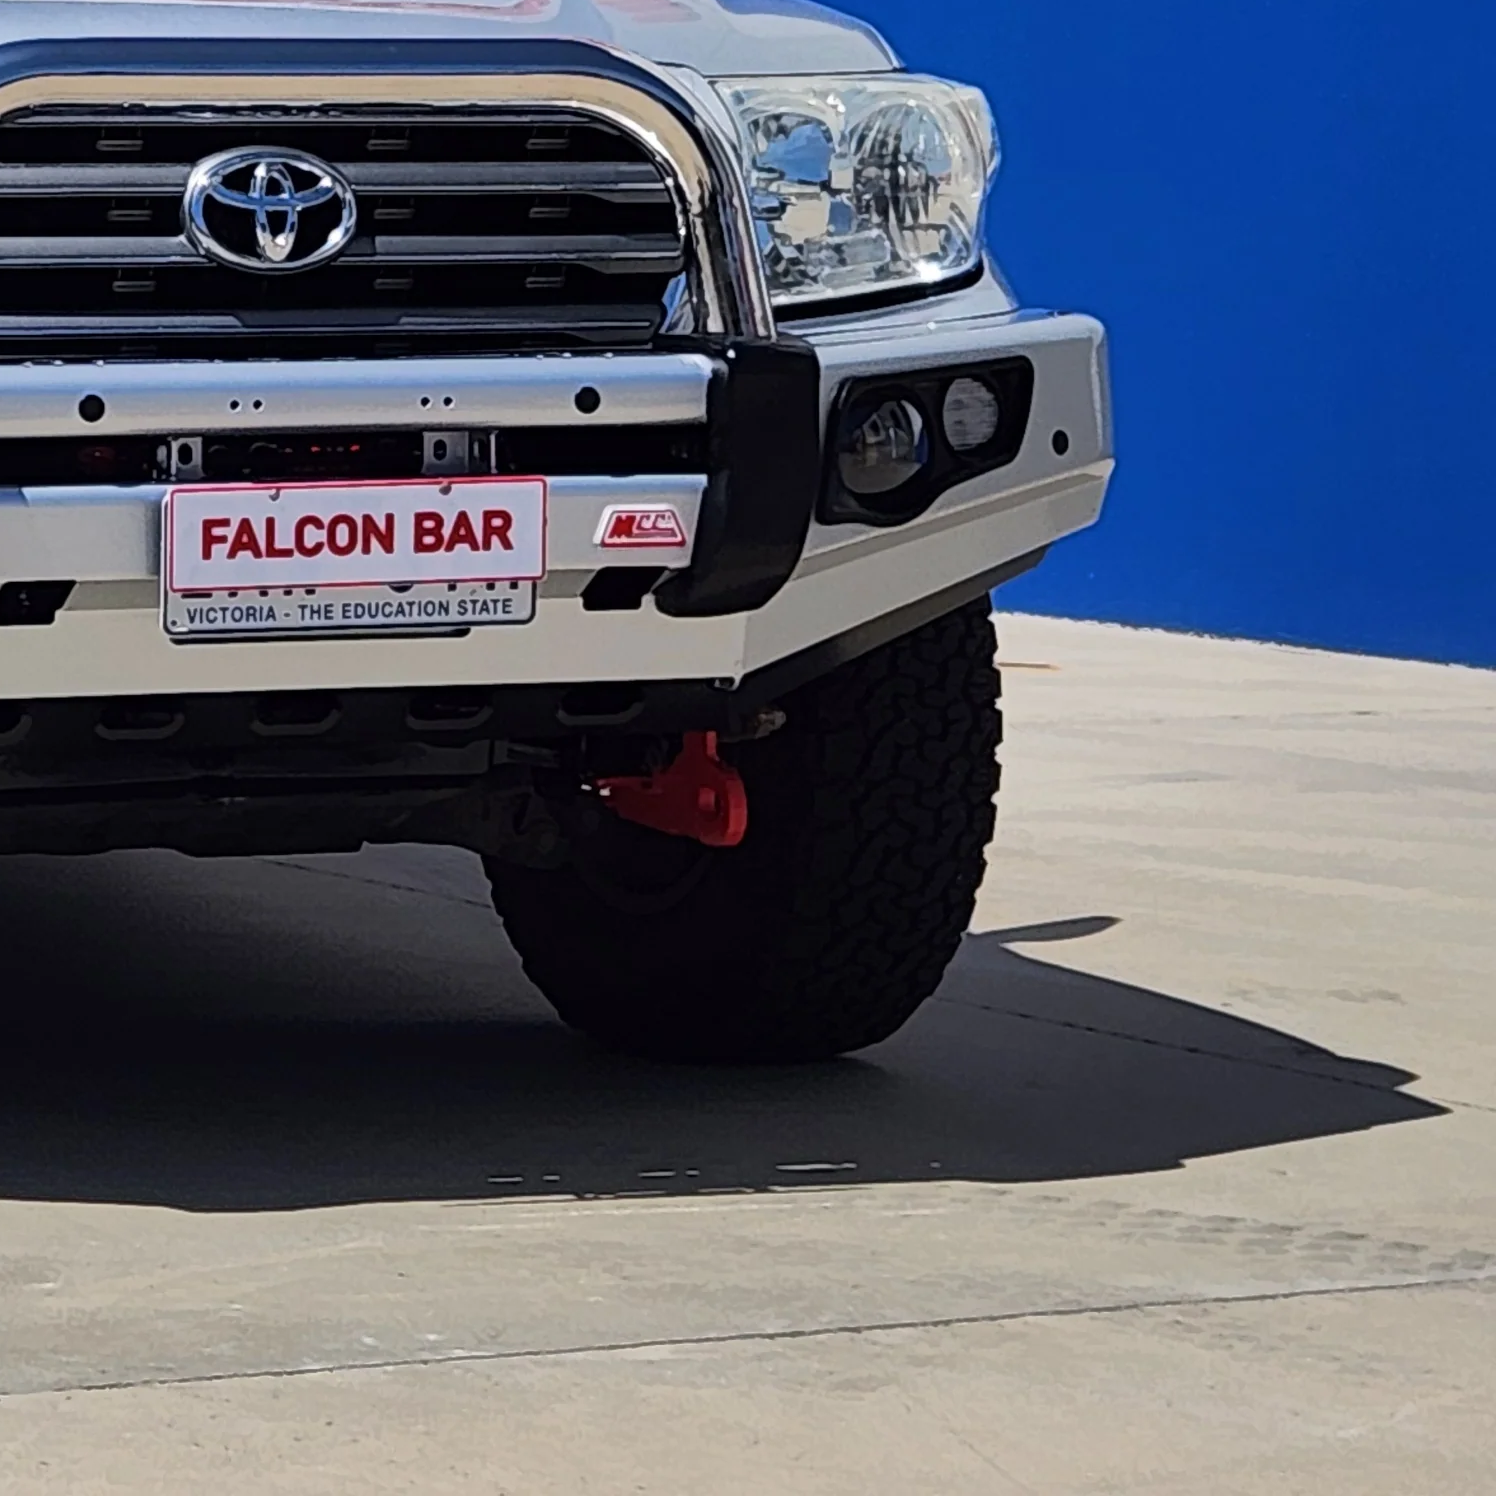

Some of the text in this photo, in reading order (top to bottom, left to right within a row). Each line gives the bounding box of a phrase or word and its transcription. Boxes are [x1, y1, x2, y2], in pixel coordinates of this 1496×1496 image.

[201, 509, 515, 561] FALCON BAR
[186, 605, 277, 625] VICTORIA
[298, 603, 334, 621] THE
[341, 599, 450, 619] EDUCATION
[457, 597, 514, 616] STATE
